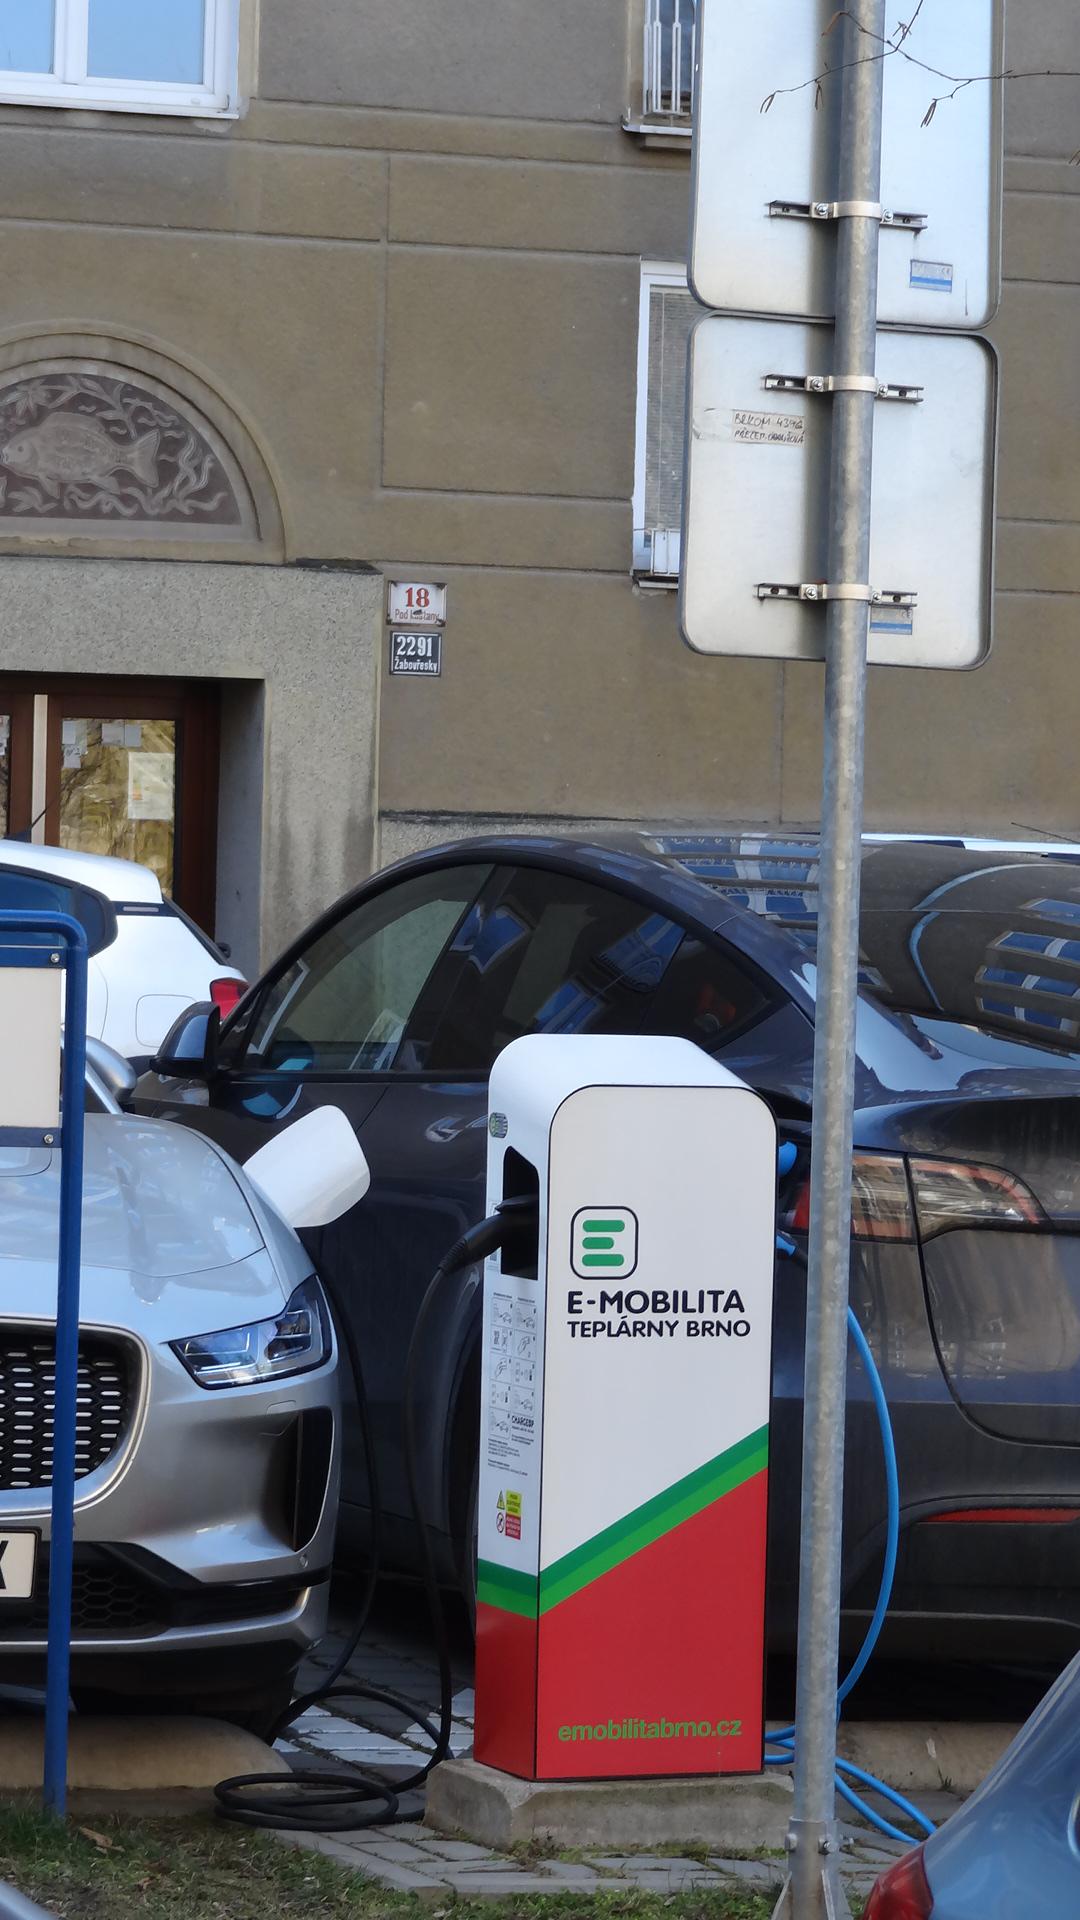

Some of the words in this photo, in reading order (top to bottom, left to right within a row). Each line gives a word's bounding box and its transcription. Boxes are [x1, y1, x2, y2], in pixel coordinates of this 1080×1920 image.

[405, 587, 430, 608] 18
[395, 608, 409, 620] Pod
[396, 636, 433, 657] 2291
[567, 1289, 746, 1315] E-MOBILITA
[567, 1315, 680, 1338] TEPLÁRNY
[686, 1319, 752, 1338] BRNO
[558, 1717, 743, 1742] emobilitabrno.cz
